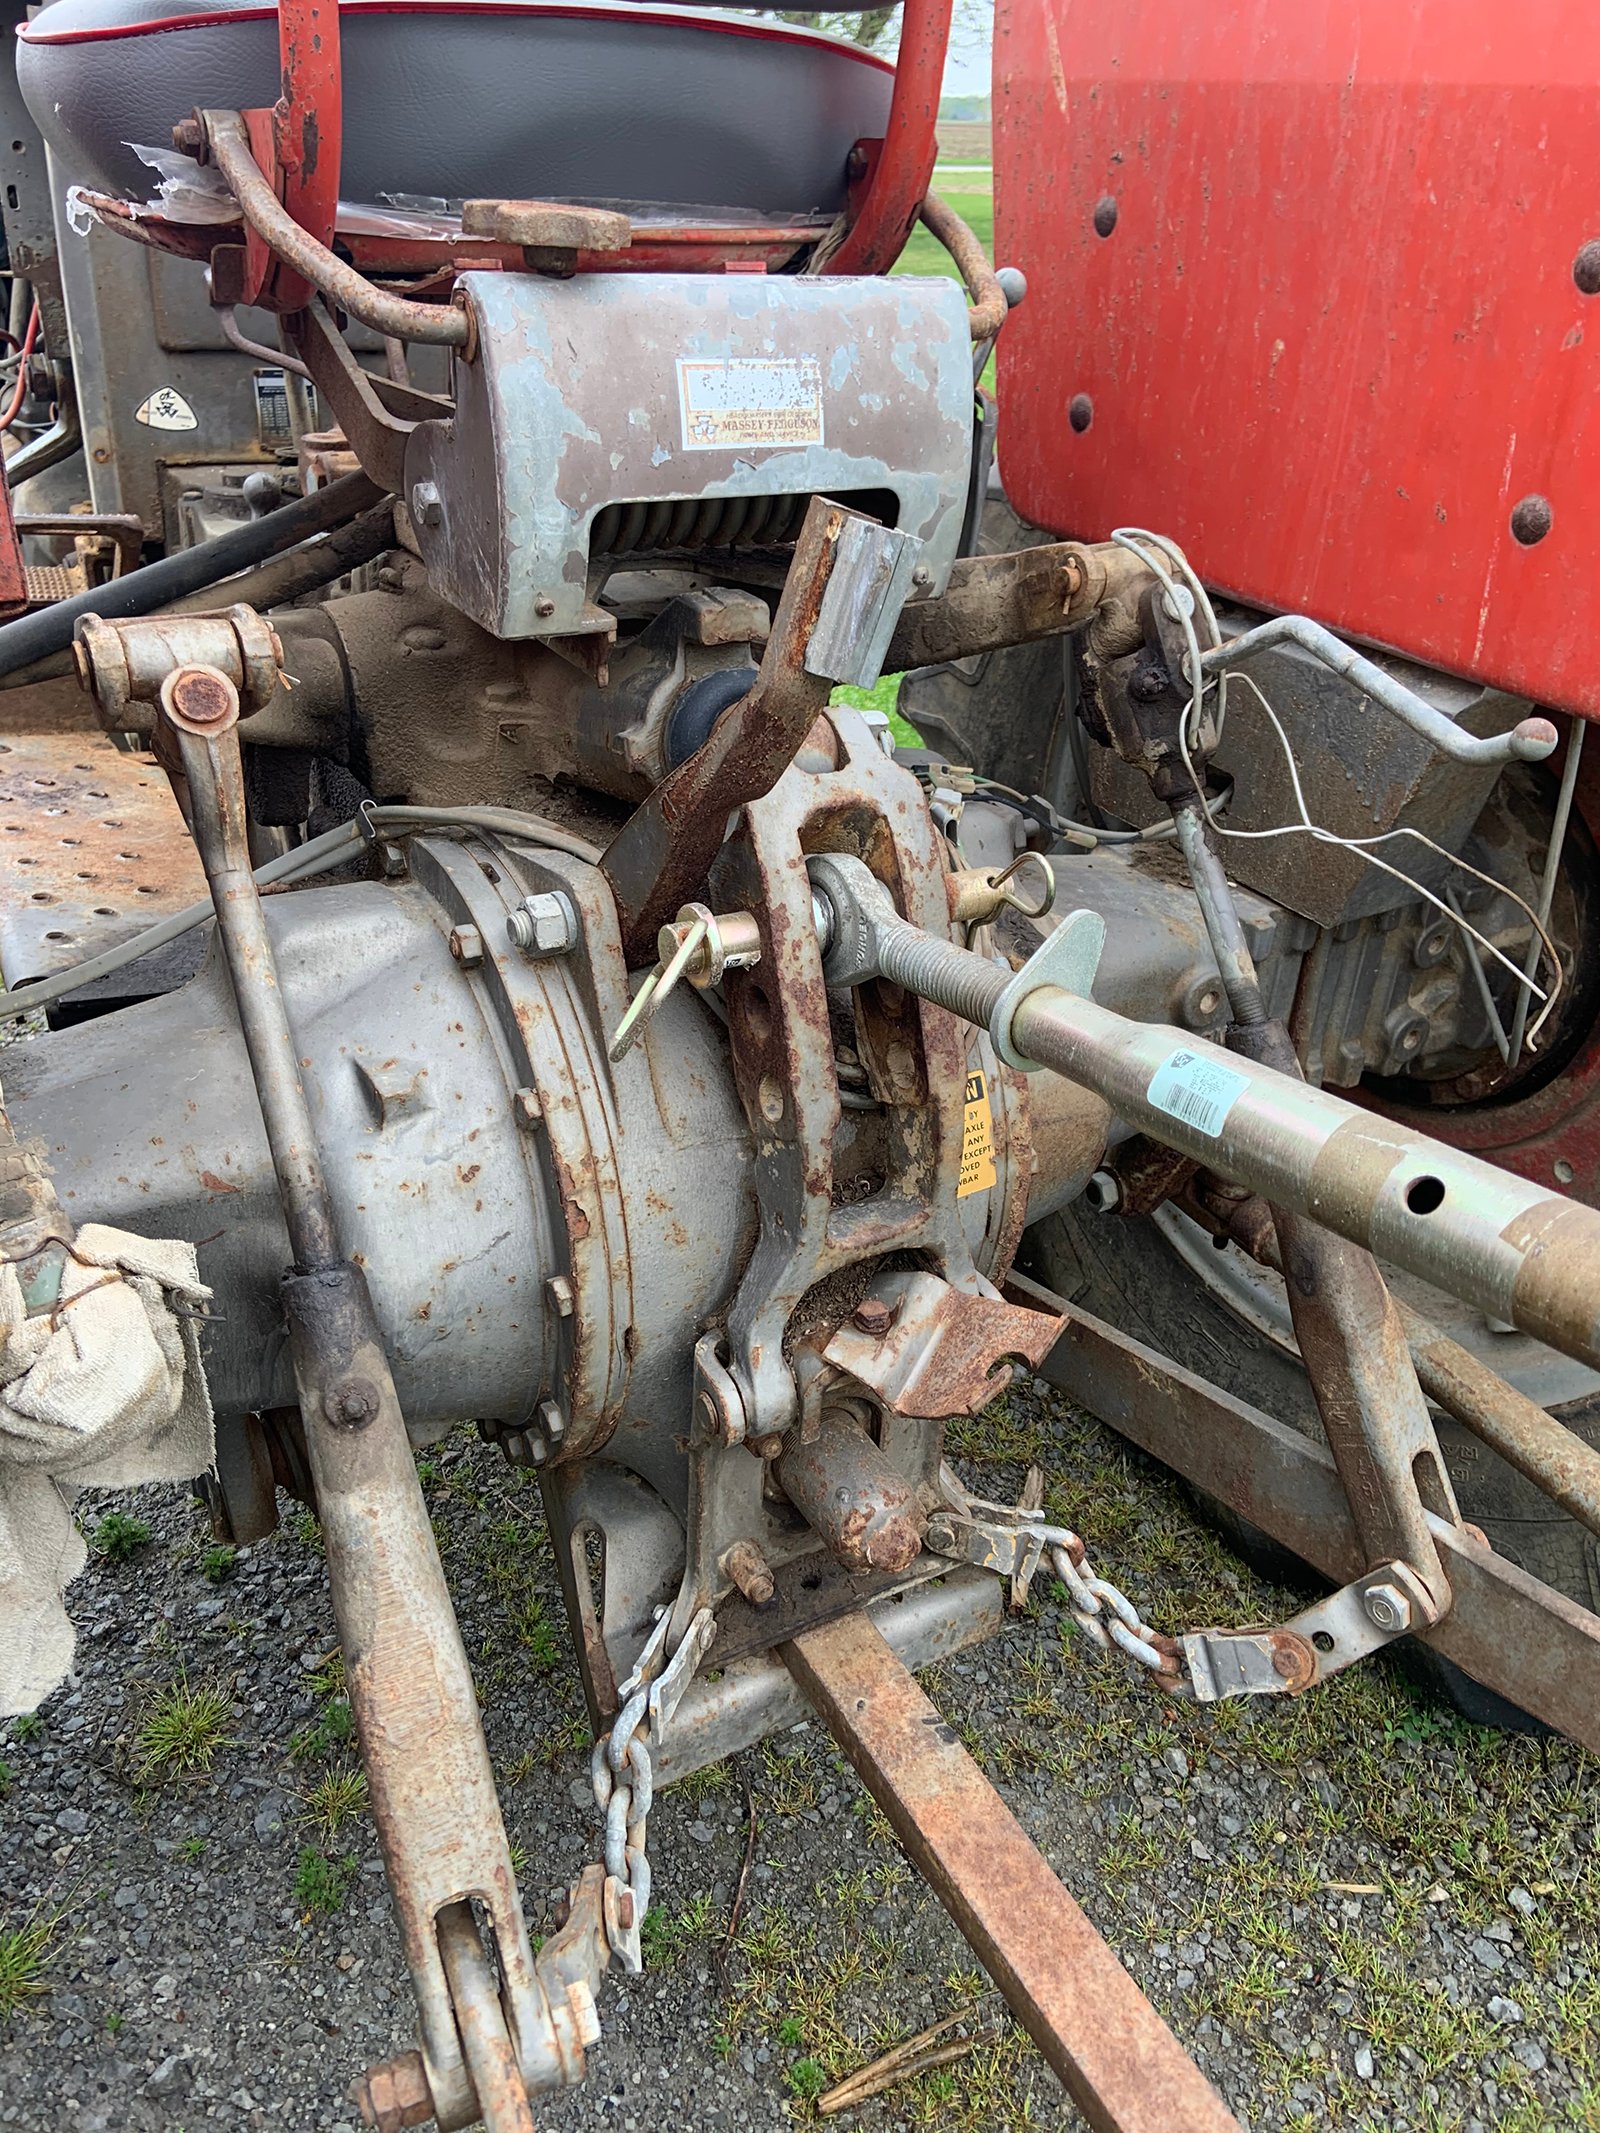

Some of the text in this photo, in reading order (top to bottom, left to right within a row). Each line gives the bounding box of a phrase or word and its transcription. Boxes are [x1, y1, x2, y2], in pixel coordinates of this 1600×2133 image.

[965, 1122, 984, 1134] AXLE
[968, 1135, 984, 1146] ANY
[964, 1145, 991, 1160] EXCEPT
[960, 1162, 980, 1174] OVED
